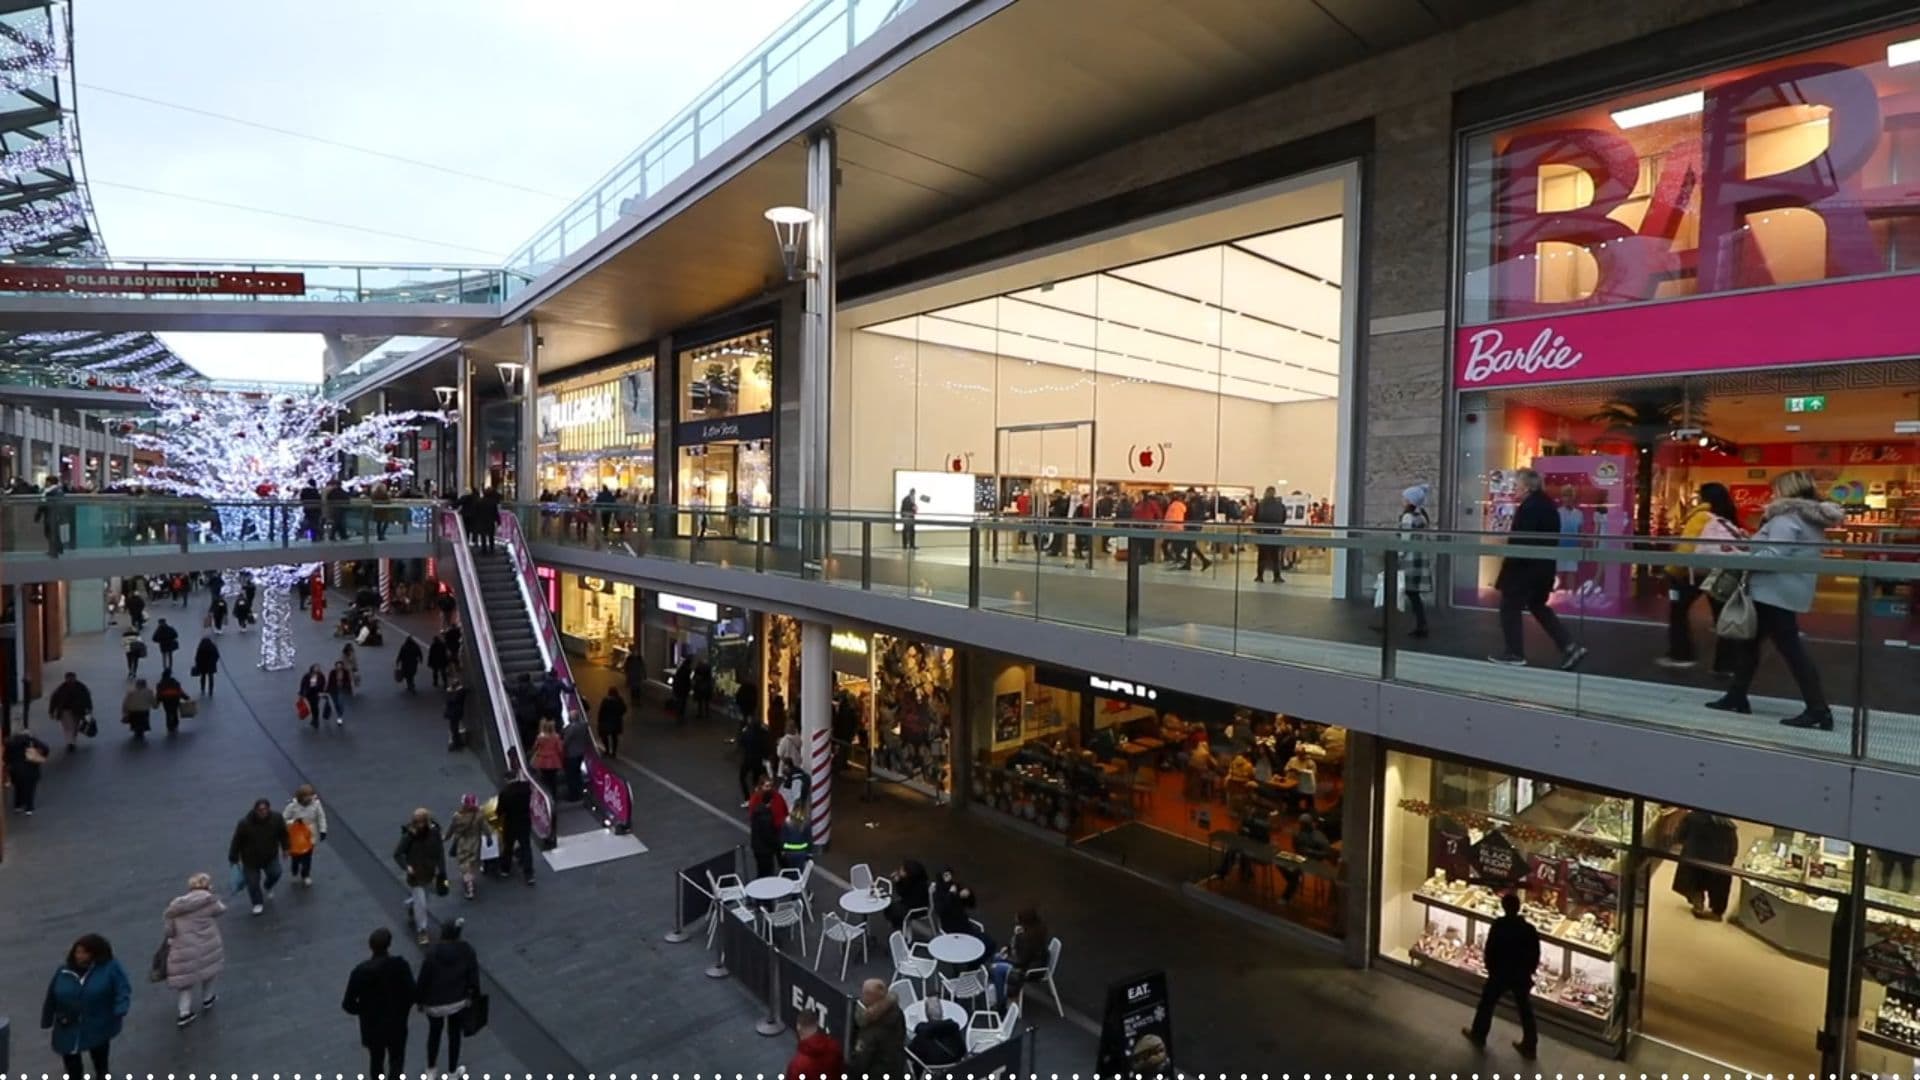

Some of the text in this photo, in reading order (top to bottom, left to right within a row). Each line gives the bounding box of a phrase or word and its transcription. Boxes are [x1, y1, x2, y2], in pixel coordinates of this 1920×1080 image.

[65, 275, 219, 288] POLAR ADVENTURE
[1464, 328, 1583, 381] Barbie
[1127, 982, 1152, 999] EAT.
[792, 984, 831, 1034] EAT.
